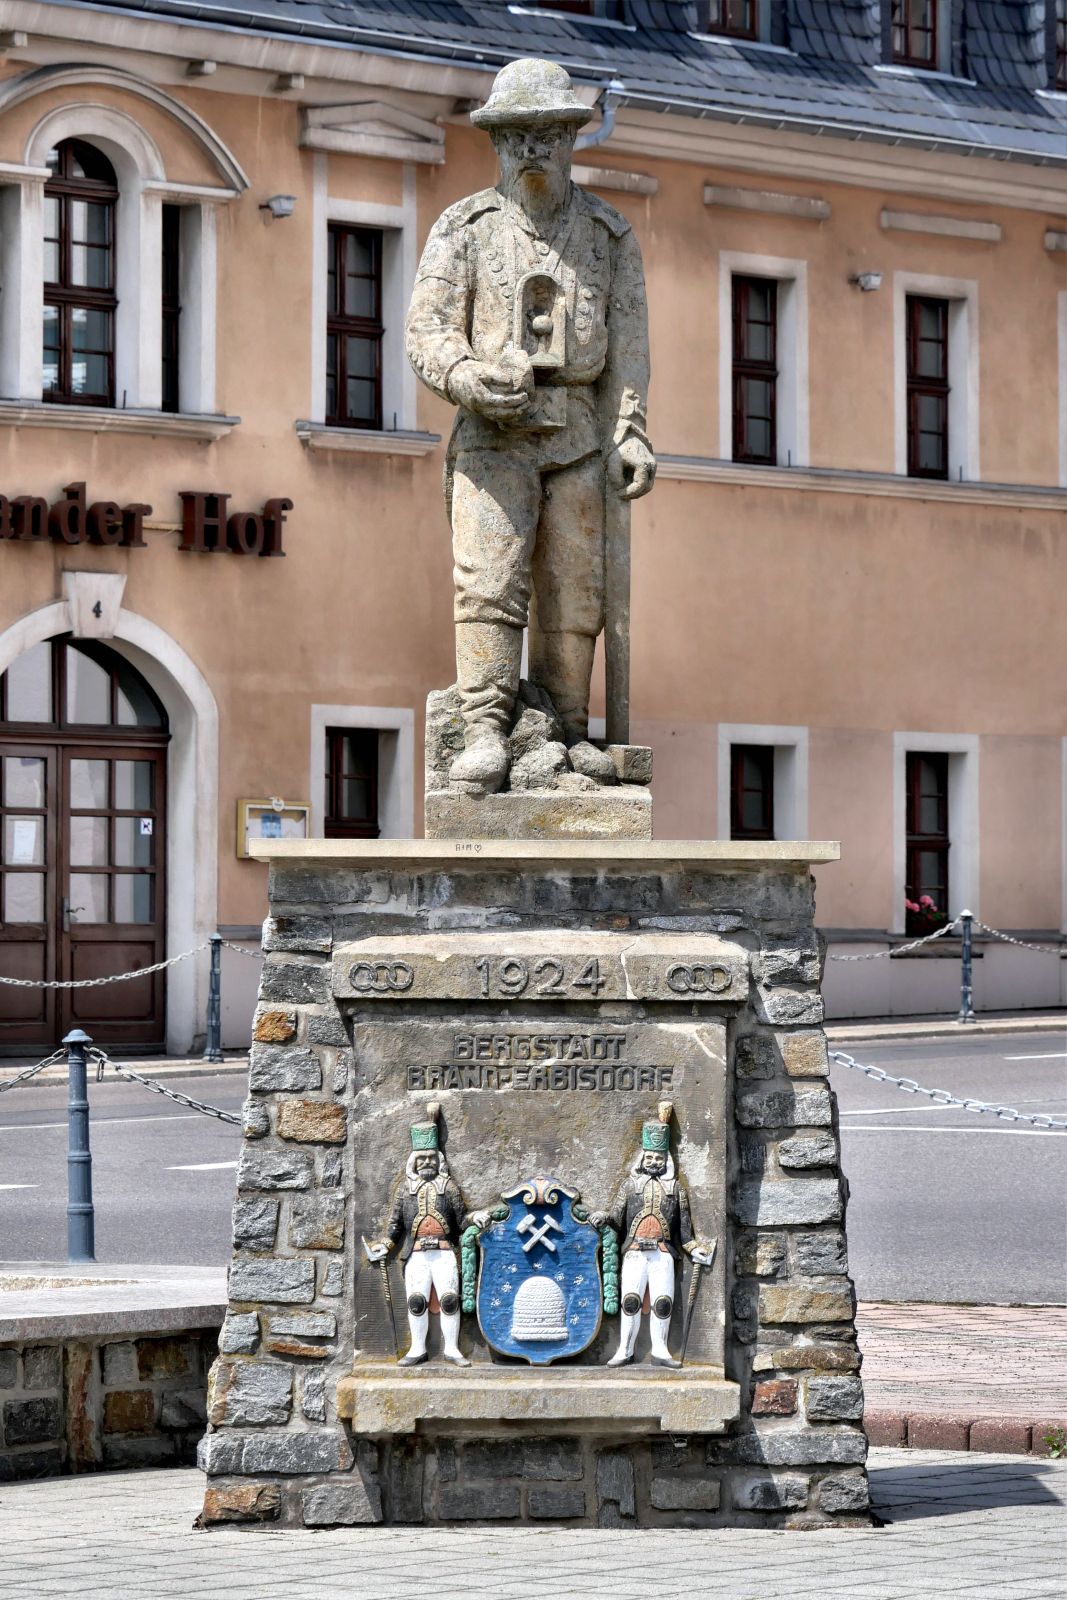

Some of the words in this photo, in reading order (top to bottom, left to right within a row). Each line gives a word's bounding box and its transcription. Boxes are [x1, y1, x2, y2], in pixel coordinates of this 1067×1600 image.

[178, 491, 294, 557] Hof
[92, 600, 102, 618] 4
[475, 957, 605, 995] 1924
[453, 1034, 626, 1060] BERGSTADT
[407, 1065, 674, 1091] BRAND-ERBISDORF
